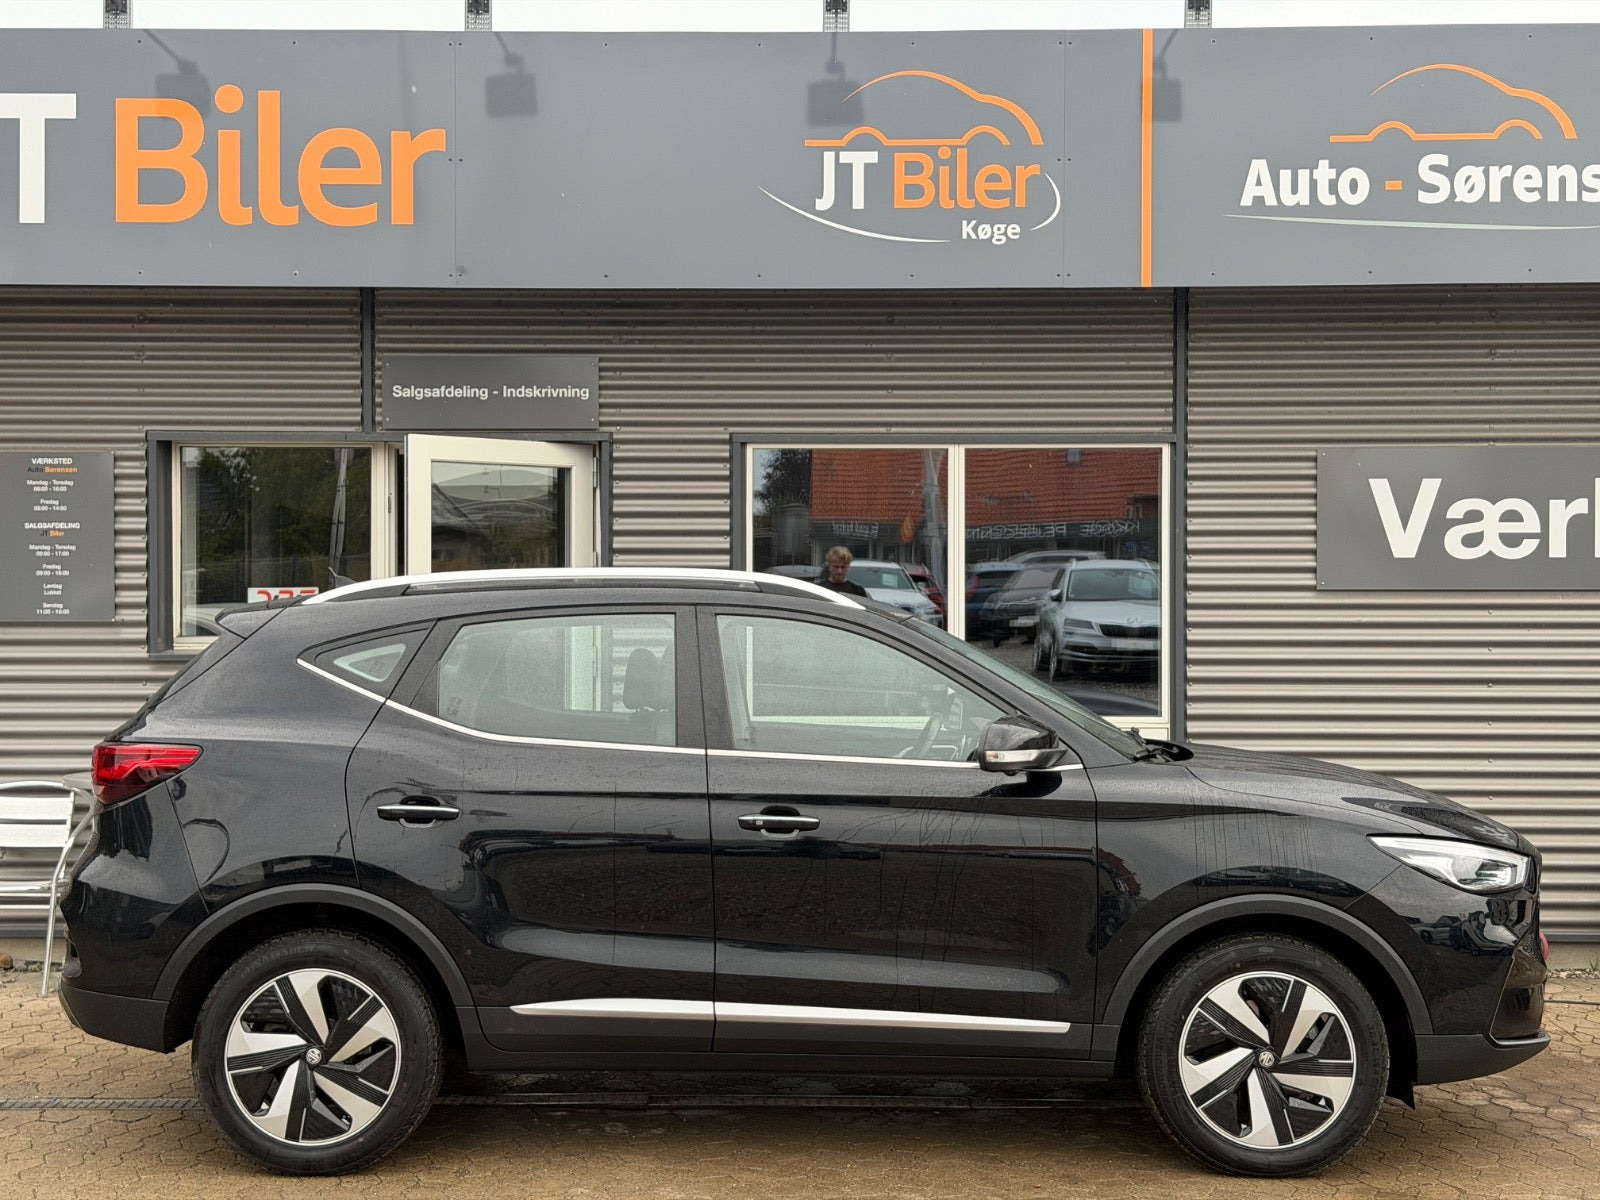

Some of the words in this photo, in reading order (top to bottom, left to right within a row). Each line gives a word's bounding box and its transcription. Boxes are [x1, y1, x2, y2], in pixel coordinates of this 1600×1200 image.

[115, 84, 447, 226] Biler
[815, 151, 879, 210] JT
[894, 146, 1041, 209] Biler
[1239, 158, 1370, 206] Auto
[1385, 180, 1403, 190] -
[1417, 153, 1600, 204] Sørens
[961, 220, 1021, 245] Køge
[392, 385, 489, 400] Salgsafdeling
[503, 385, 590, 400] Indskrivning
[31, 457, 73, 465] VÆRKSTED
[1368, 478, 1600, 560] Vær
